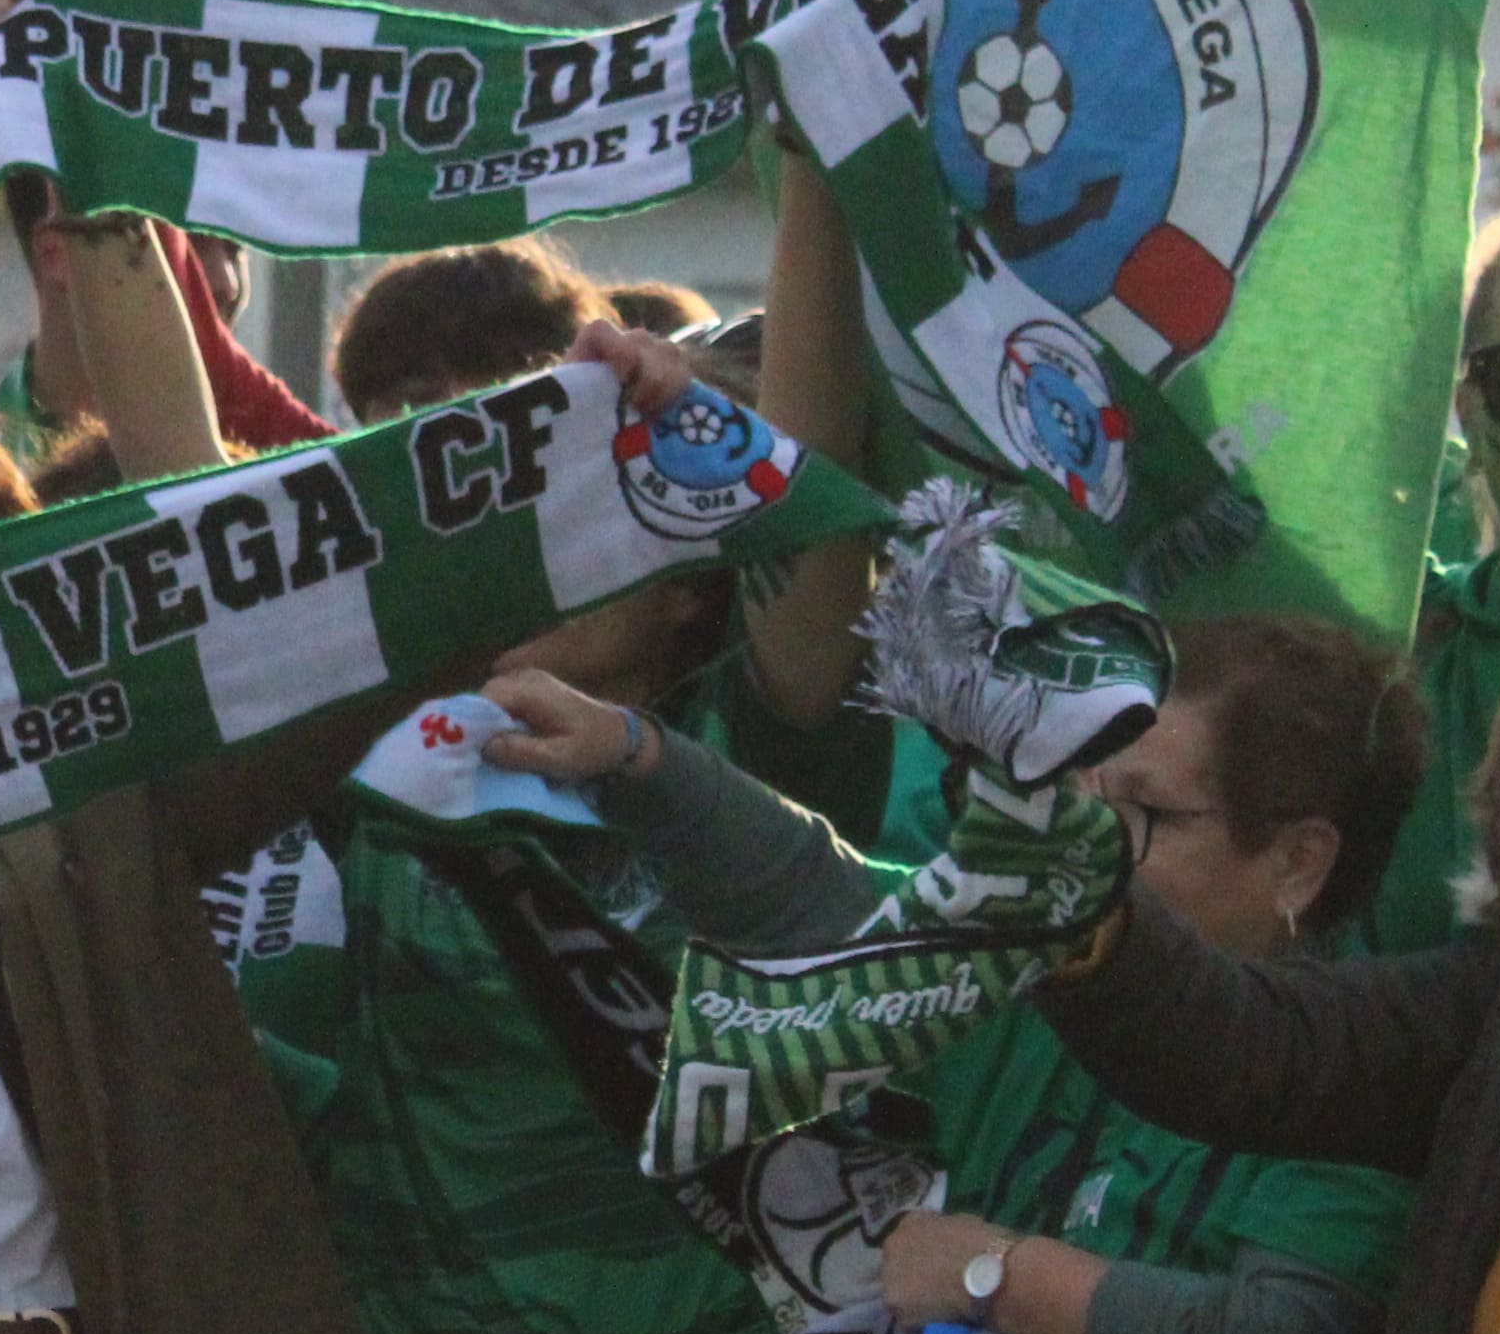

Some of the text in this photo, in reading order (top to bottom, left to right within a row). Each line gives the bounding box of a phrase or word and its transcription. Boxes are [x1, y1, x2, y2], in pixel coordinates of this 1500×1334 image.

[512, 15, 680, 137] DE
[429, 125, 629, 201] DESDE
[4, 453, 384, 678] VEGA
[408, 375, 571, 537] CF
